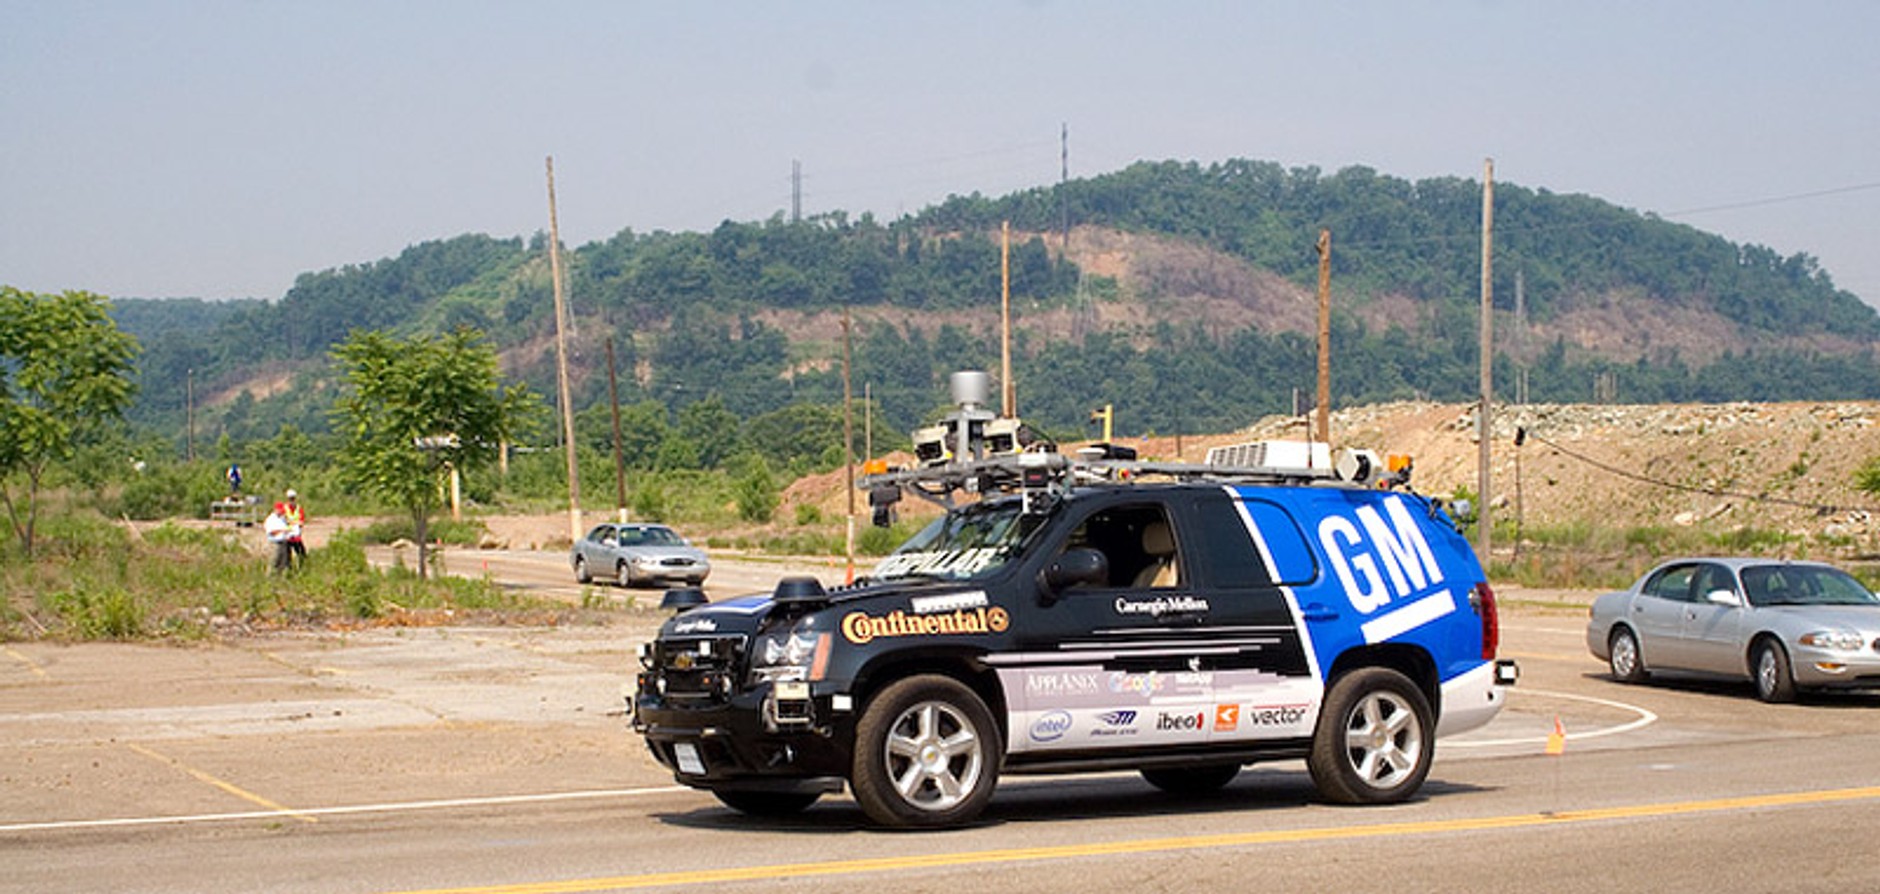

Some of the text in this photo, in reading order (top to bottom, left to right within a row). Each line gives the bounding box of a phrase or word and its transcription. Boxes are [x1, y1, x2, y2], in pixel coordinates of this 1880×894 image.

[1318, 494, 1444, 614] GM
[842, 606, 989, 643] Continental
[1156, 713, 1196, 730] ibeo
[1251, 706, 1306, 726] vector
